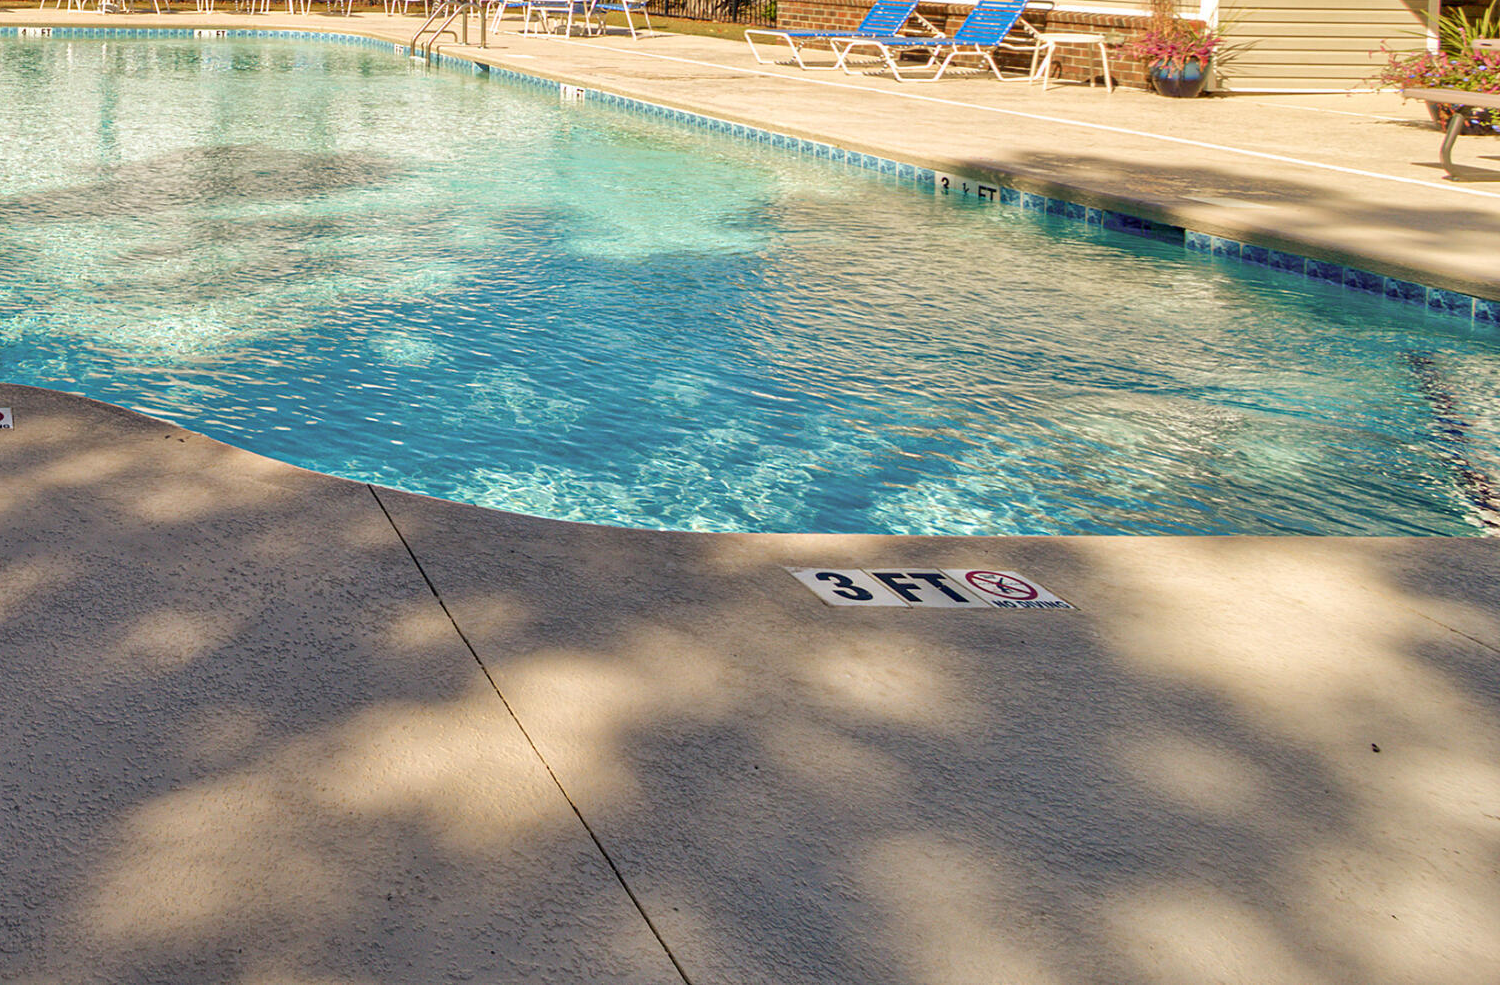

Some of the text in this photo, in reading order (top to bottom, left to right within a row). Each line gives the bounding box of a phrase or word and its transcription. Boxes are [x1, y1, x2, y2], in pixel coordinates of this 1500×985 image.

[41, 28, 51, 37] FT
[979, 184, 997, 201] FT
[815, 572, 970, 603] 3 FT
[991, 600, 1071, 609] NO DIVING
